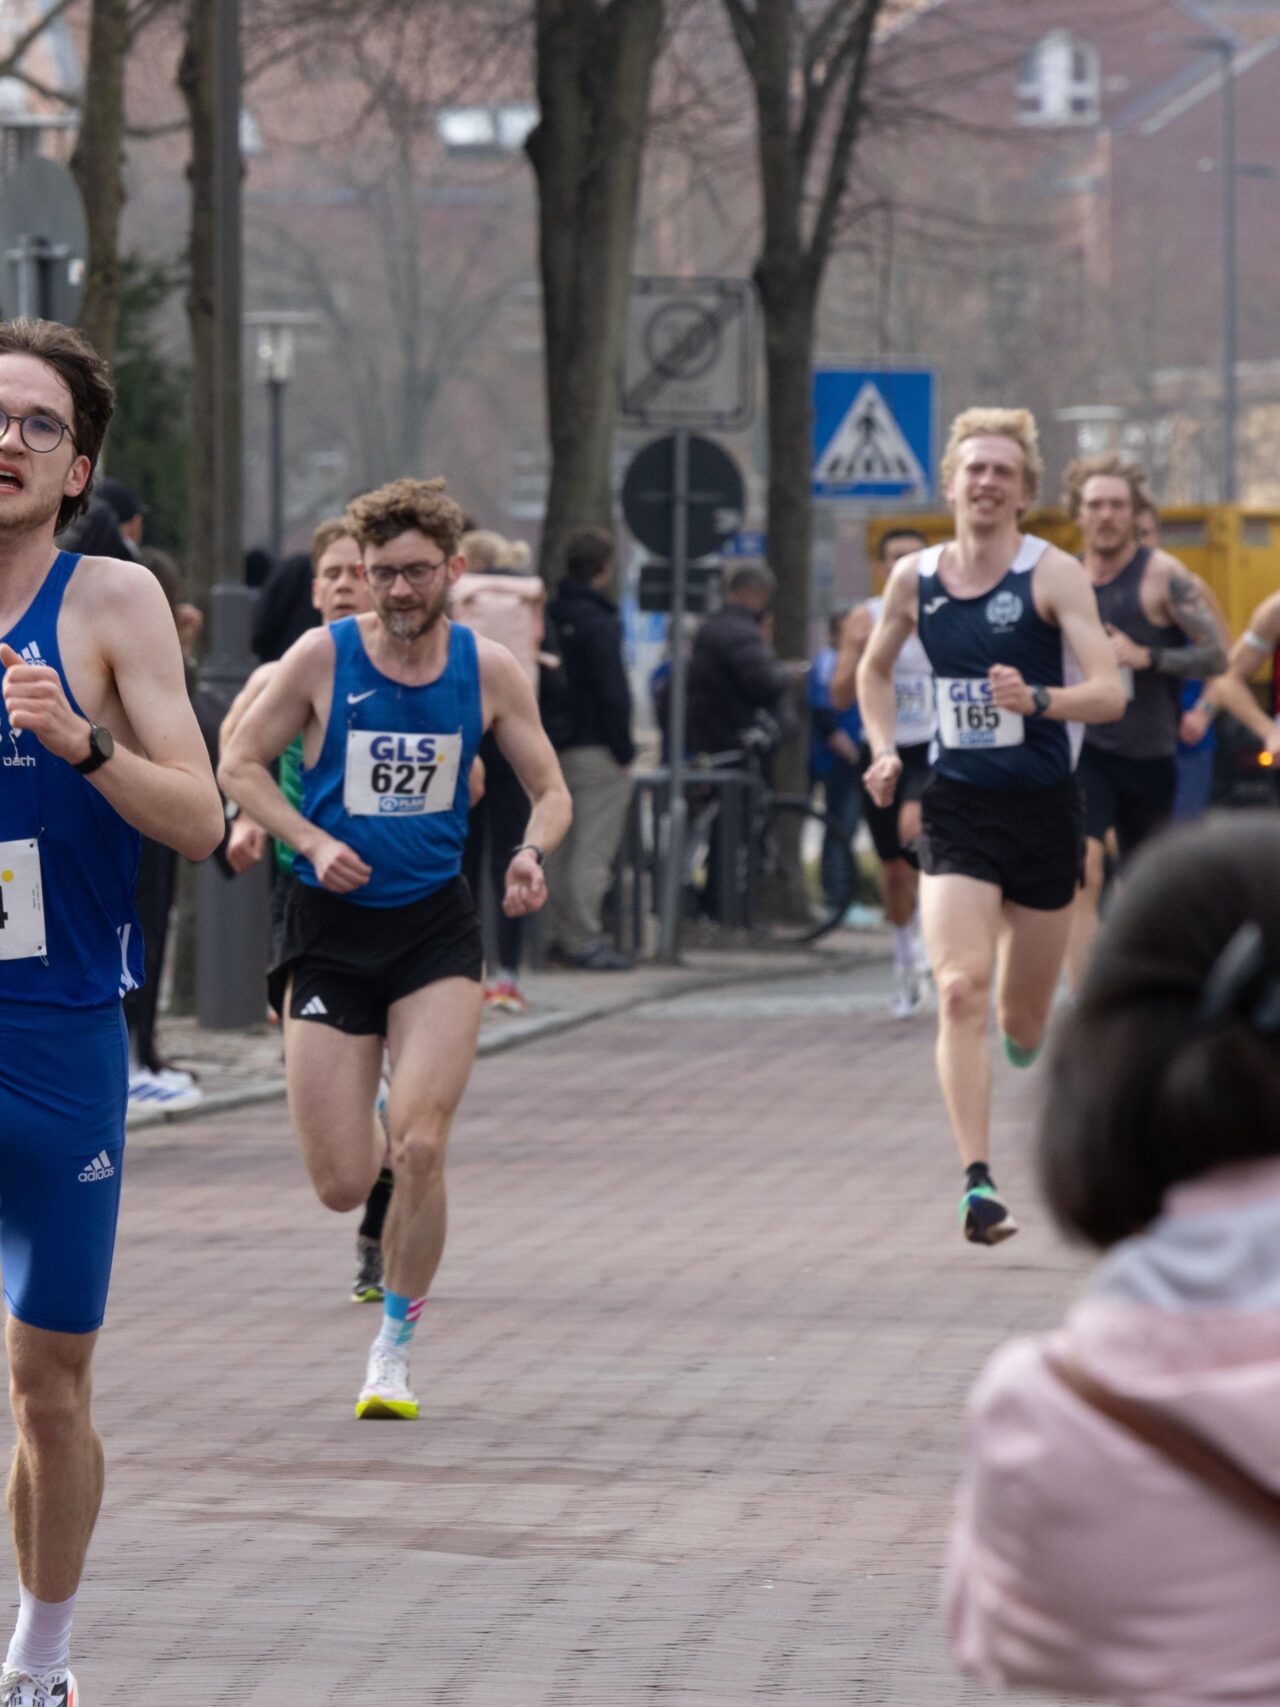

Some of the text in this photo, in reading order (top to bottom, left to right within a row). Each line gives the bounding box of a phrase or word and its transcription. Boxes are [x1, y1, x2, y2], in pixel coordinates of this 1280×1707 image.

[953, 705, 1000, 729] 165
[371, 763, 437, 794] 627
[77, 1166, 115, 1182] adidas
